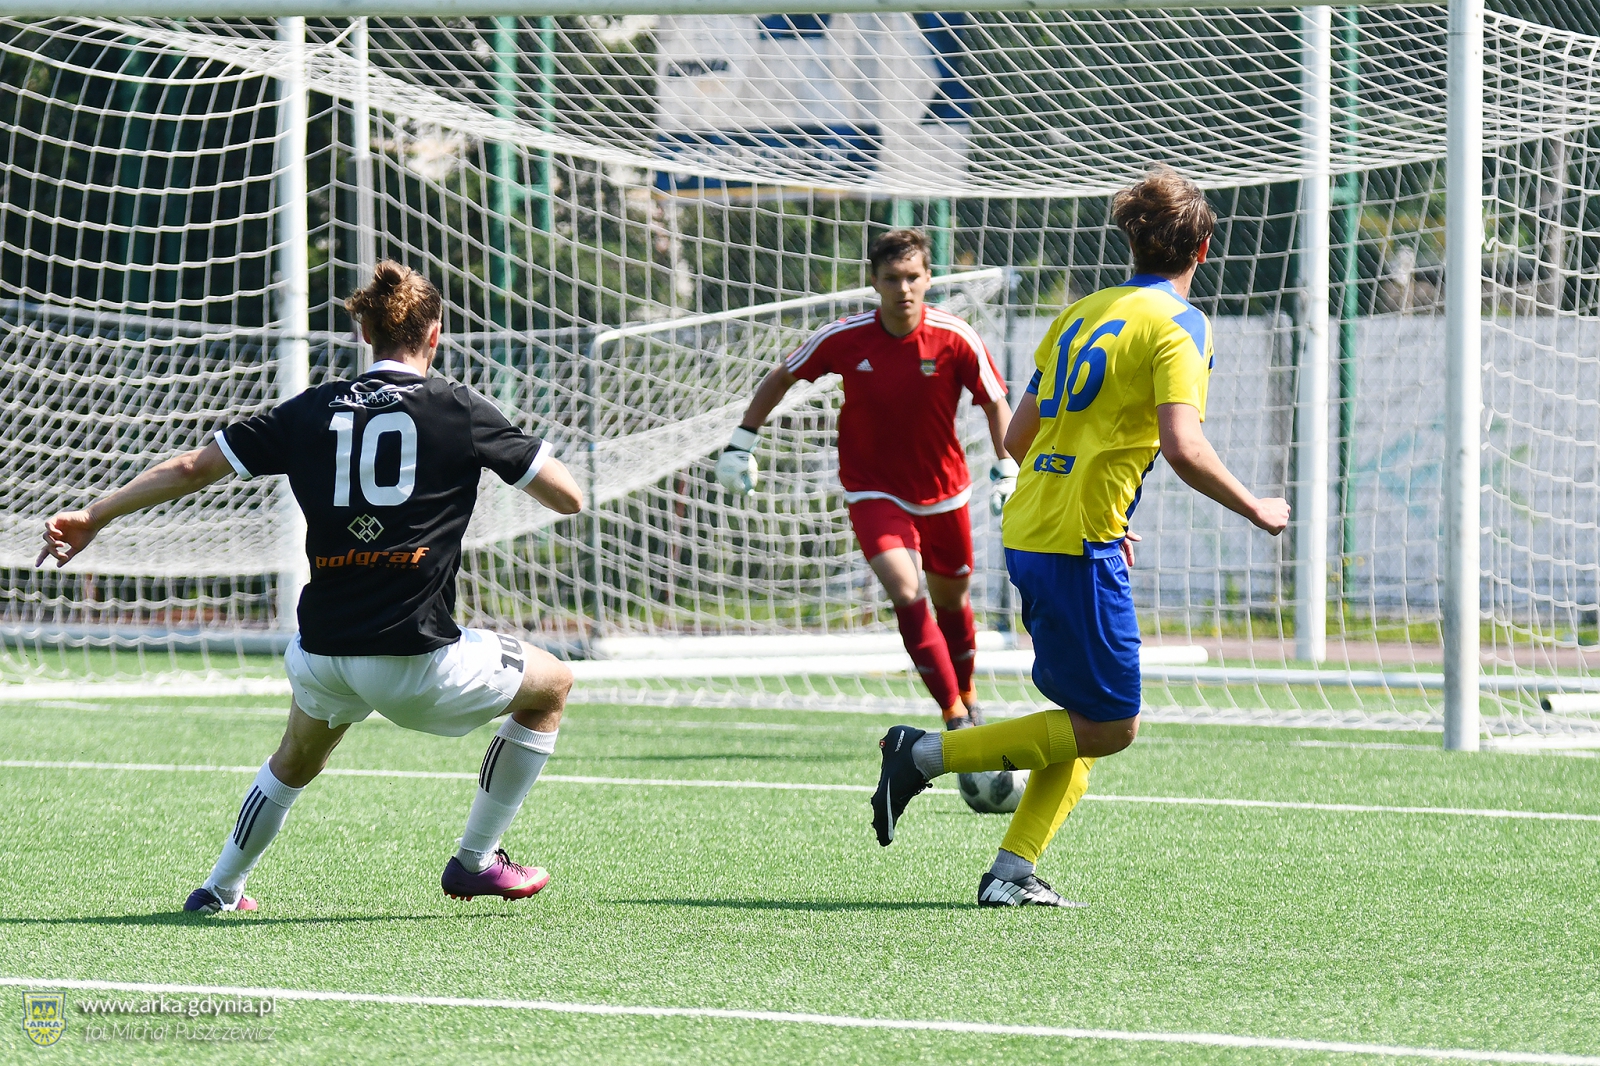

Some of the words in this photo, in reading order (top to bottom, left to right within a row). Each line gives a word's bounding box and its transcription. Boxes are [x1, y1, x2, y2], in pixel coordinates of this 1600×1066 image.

[1039, 317, 1127, 418] 16
[328, 411, 418, 507] 10
[315, 546, 430, 569] polgraf
